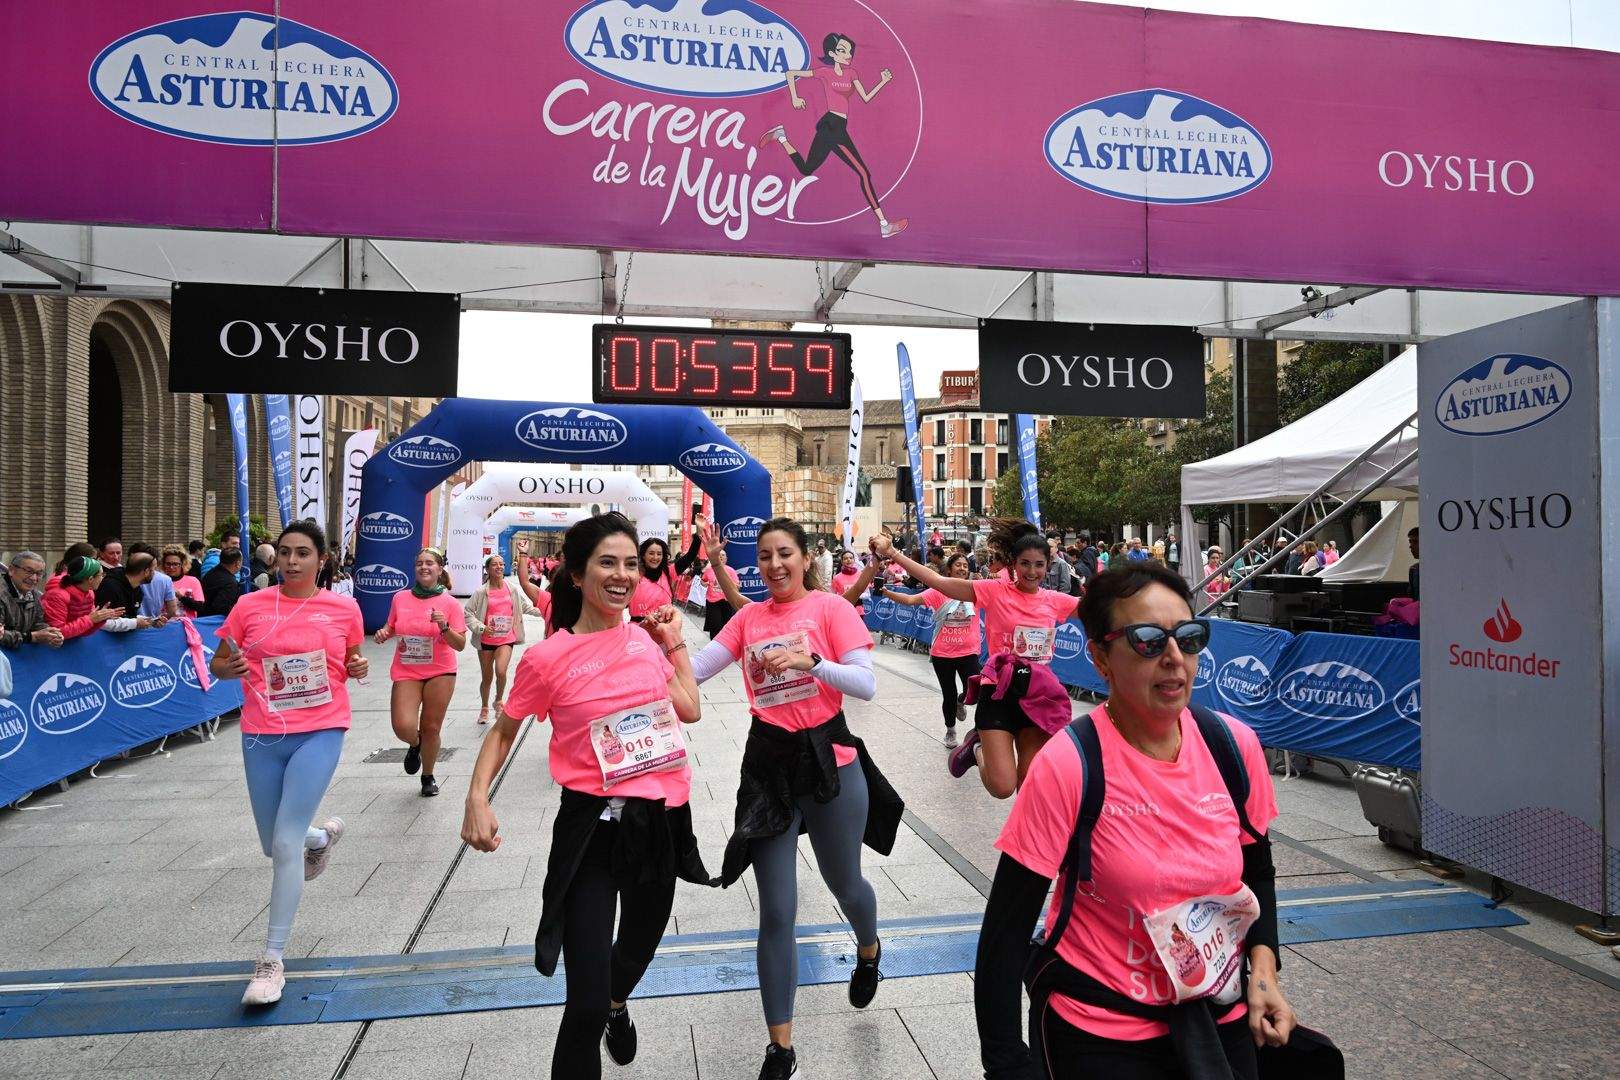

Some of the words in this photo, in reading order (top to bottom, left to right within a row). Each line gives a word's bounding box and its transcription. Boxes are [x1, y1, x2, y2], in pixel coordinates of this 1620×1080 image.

[624, 16, 701, 34] CENTRAL
[709, 24, 785, 41] LECHERA
[584, 16, 790, 74] ASTURIANA
[164, 53, 260, 72] CENTRAL
[269, 60, 366, 79] LECHERA
[114, 53, 376, 118] ASTURIANA
[542, 78, 746, 150] Carrera
[1098, 125, 1171, 141] CENTRAL
[1177, 131, 1249, 146] LECHERA
[1062, 125, 1256, 179] ASTURIANA
[593, 144, 631, 185] de
[640, 145, 667, 188] la
[1378, 150, 1536, 196] OYSHO
[660, 146, 819, 241] Mujer
[219, 319, 420, 365] OYSHO
[944, 376, 975, 387] TIBUR
[1017, 353, 1174, 390] OYSHO
[1462, 383, 1504, 397] CENTRAL
[1507, 372, 1555, 388] LECHERA
[1443, 383, 1561, 423] ASTURIANA
[524, 419, 619, 442] ASTURIANA
[393, 446, 456, 461] ASTURIANA
[685, 455, 742, 467] ASTURIANA
[519, 476, 605, 495] OYSHO
[1438, 492, 1572, 532] OYSHO
[360, 521, 410, 535] ASTURIANA
[727, 528, 759, 538] ASTURI
[356, 573, 405, 587] ASTURIANA
[740, 579, 766, 588] TURIA
[567, 659, 605, 678] OYSHO
[1449, 644, 1561, 679] Santander
[117, 673, 174, 701] ASTURIANA
[286, 675, 309, 685] 016
[44, 694, 68, 705] CENTRAL
[1283, 679, 1375, 709] ASTURIANA
[38, 693, 103, 726] ASTURIANA
[625, 735, 654, 753] 016
[634, 750, 653, 762] 6867
[614, 767, 638, 777] CARRERA
[1101, 801, 1161, 818] OYSHO
[1203, 928, 1224, 961] 016
[1130, 971, 1173, 1002] SU
